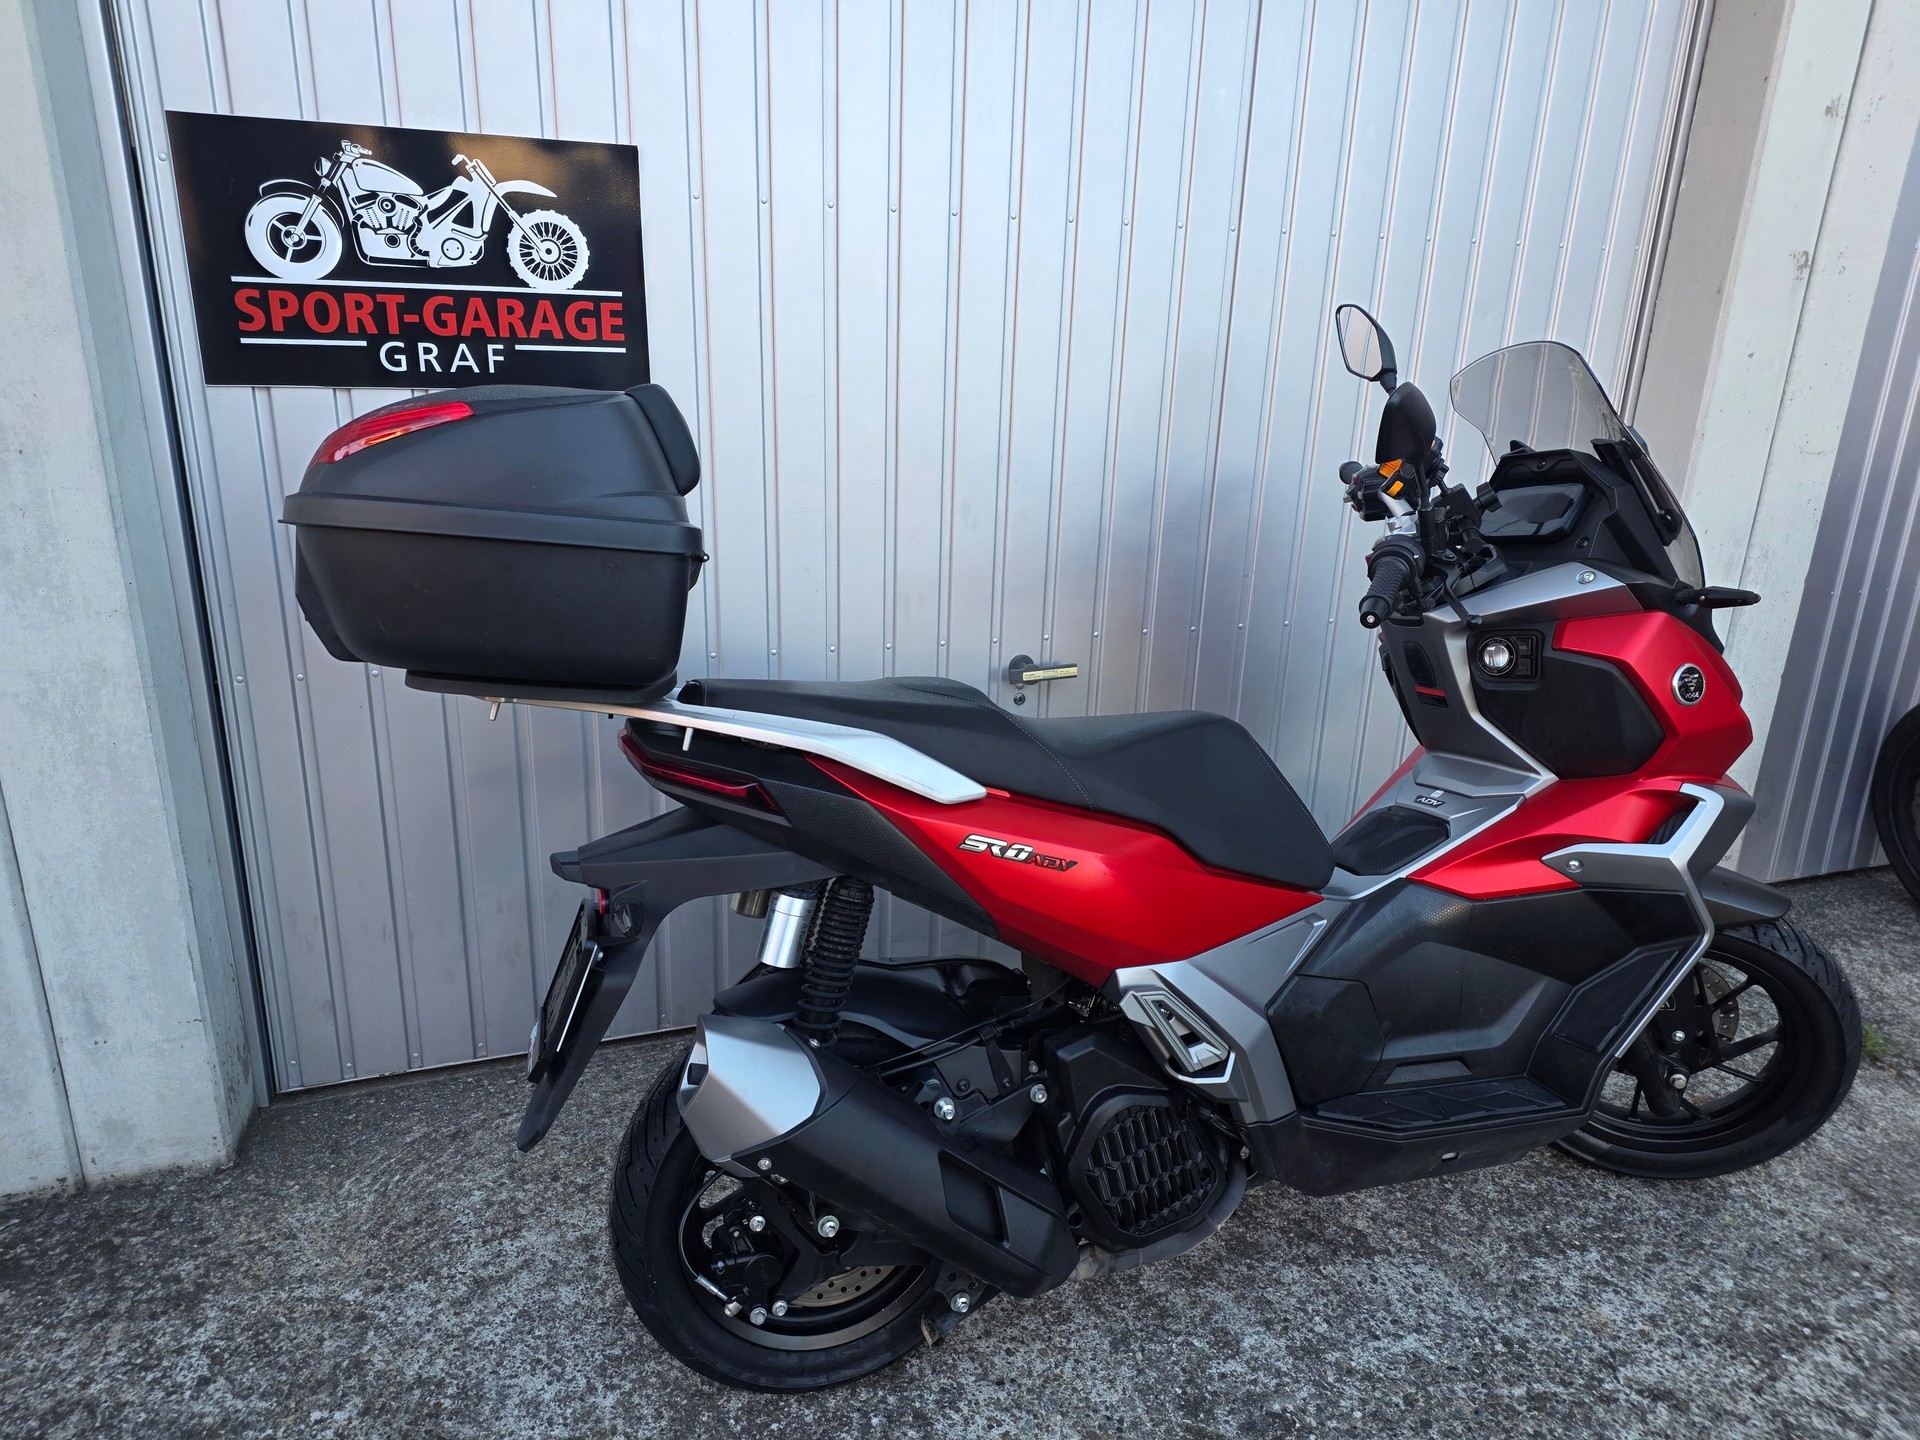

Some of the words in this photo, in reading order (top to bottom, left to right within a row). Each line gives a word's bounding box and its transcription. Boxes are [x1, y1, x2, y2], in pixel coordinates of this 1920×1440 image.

[234, 288, 626, 342] SPORT-GARAGE
[379, 341, 505, 374] GRAF
[1416, 796, 1443, 806] ADV
[1028, 854, 1079, 872] ADV
